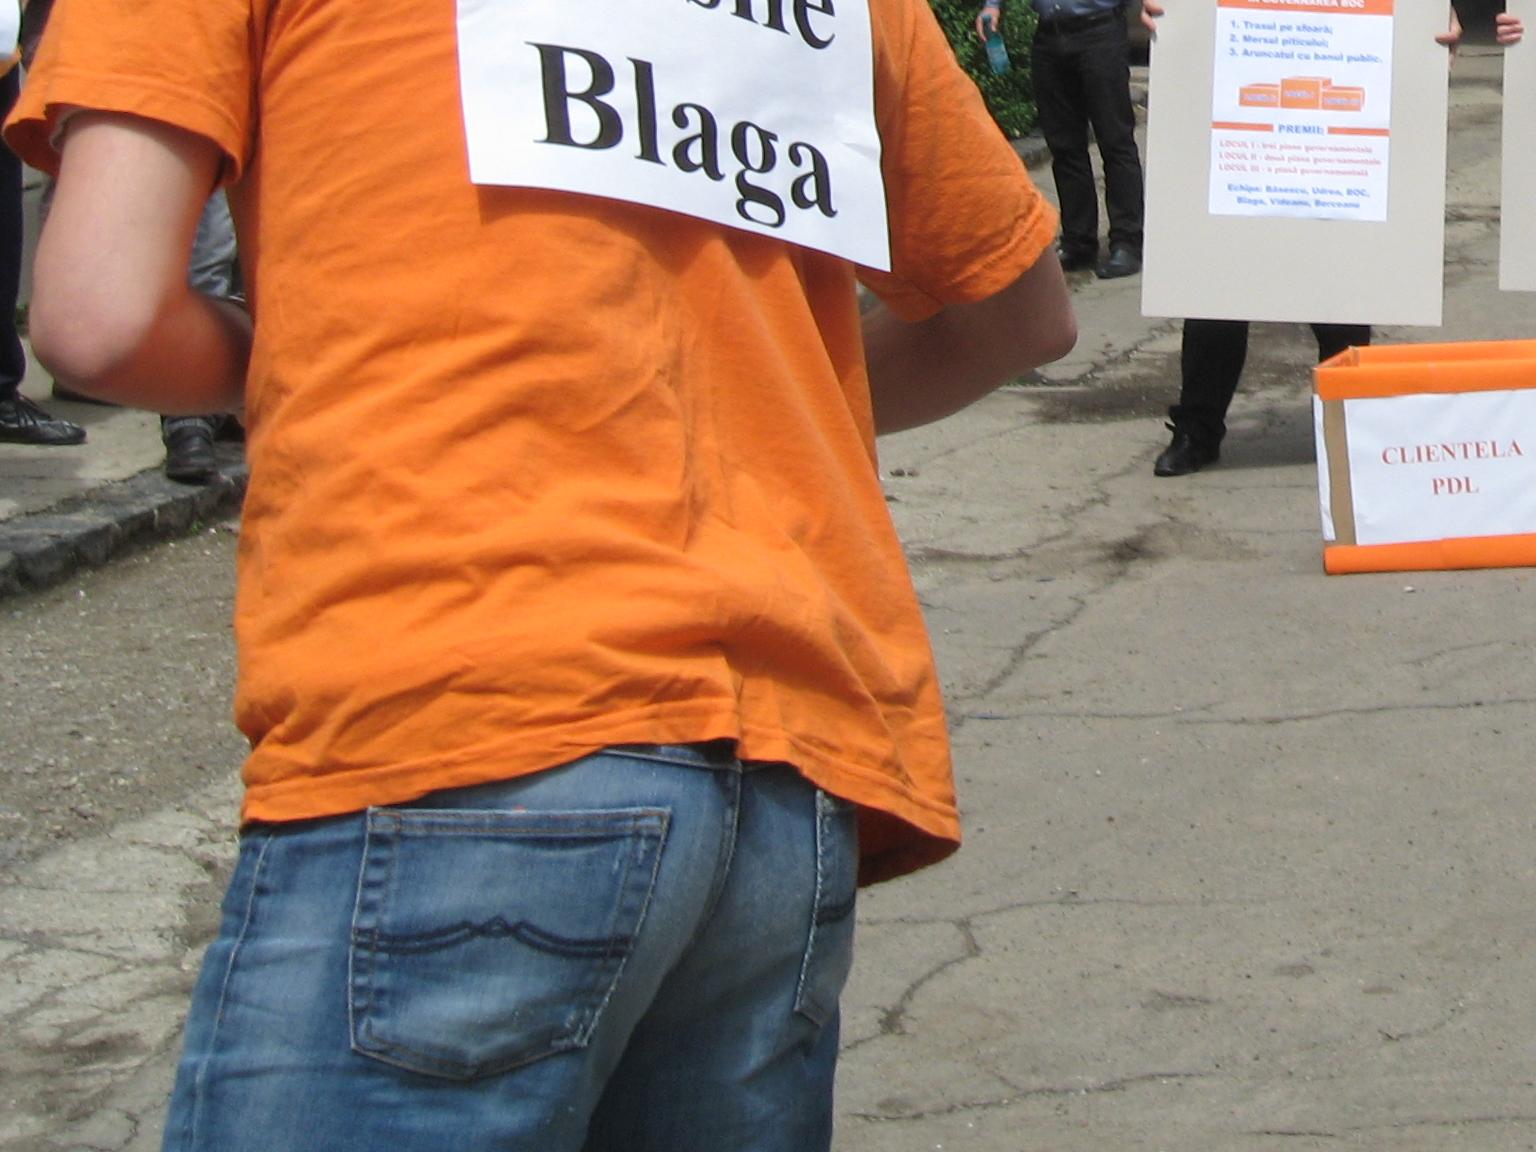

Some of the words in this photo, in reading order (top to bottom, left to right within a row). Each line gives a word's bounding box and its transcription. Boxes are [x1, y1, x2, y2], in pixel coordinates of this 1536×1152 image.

[1243, 20, 1277, 32] Trasul
[1279, 24, 1292, 34] pe
[1242, 35, 1279, 45] Mersul
[1242, 49, 1294, 60] Aruncatul
[1298, 52, 1311, 60] cu
[1314, 51, 1343, 62] banul
[524, 41, 838, 229] Blaga
[1381, 439, 1523, 466] CLIENTELA
[1431, 476, 1480, 496] PDL
